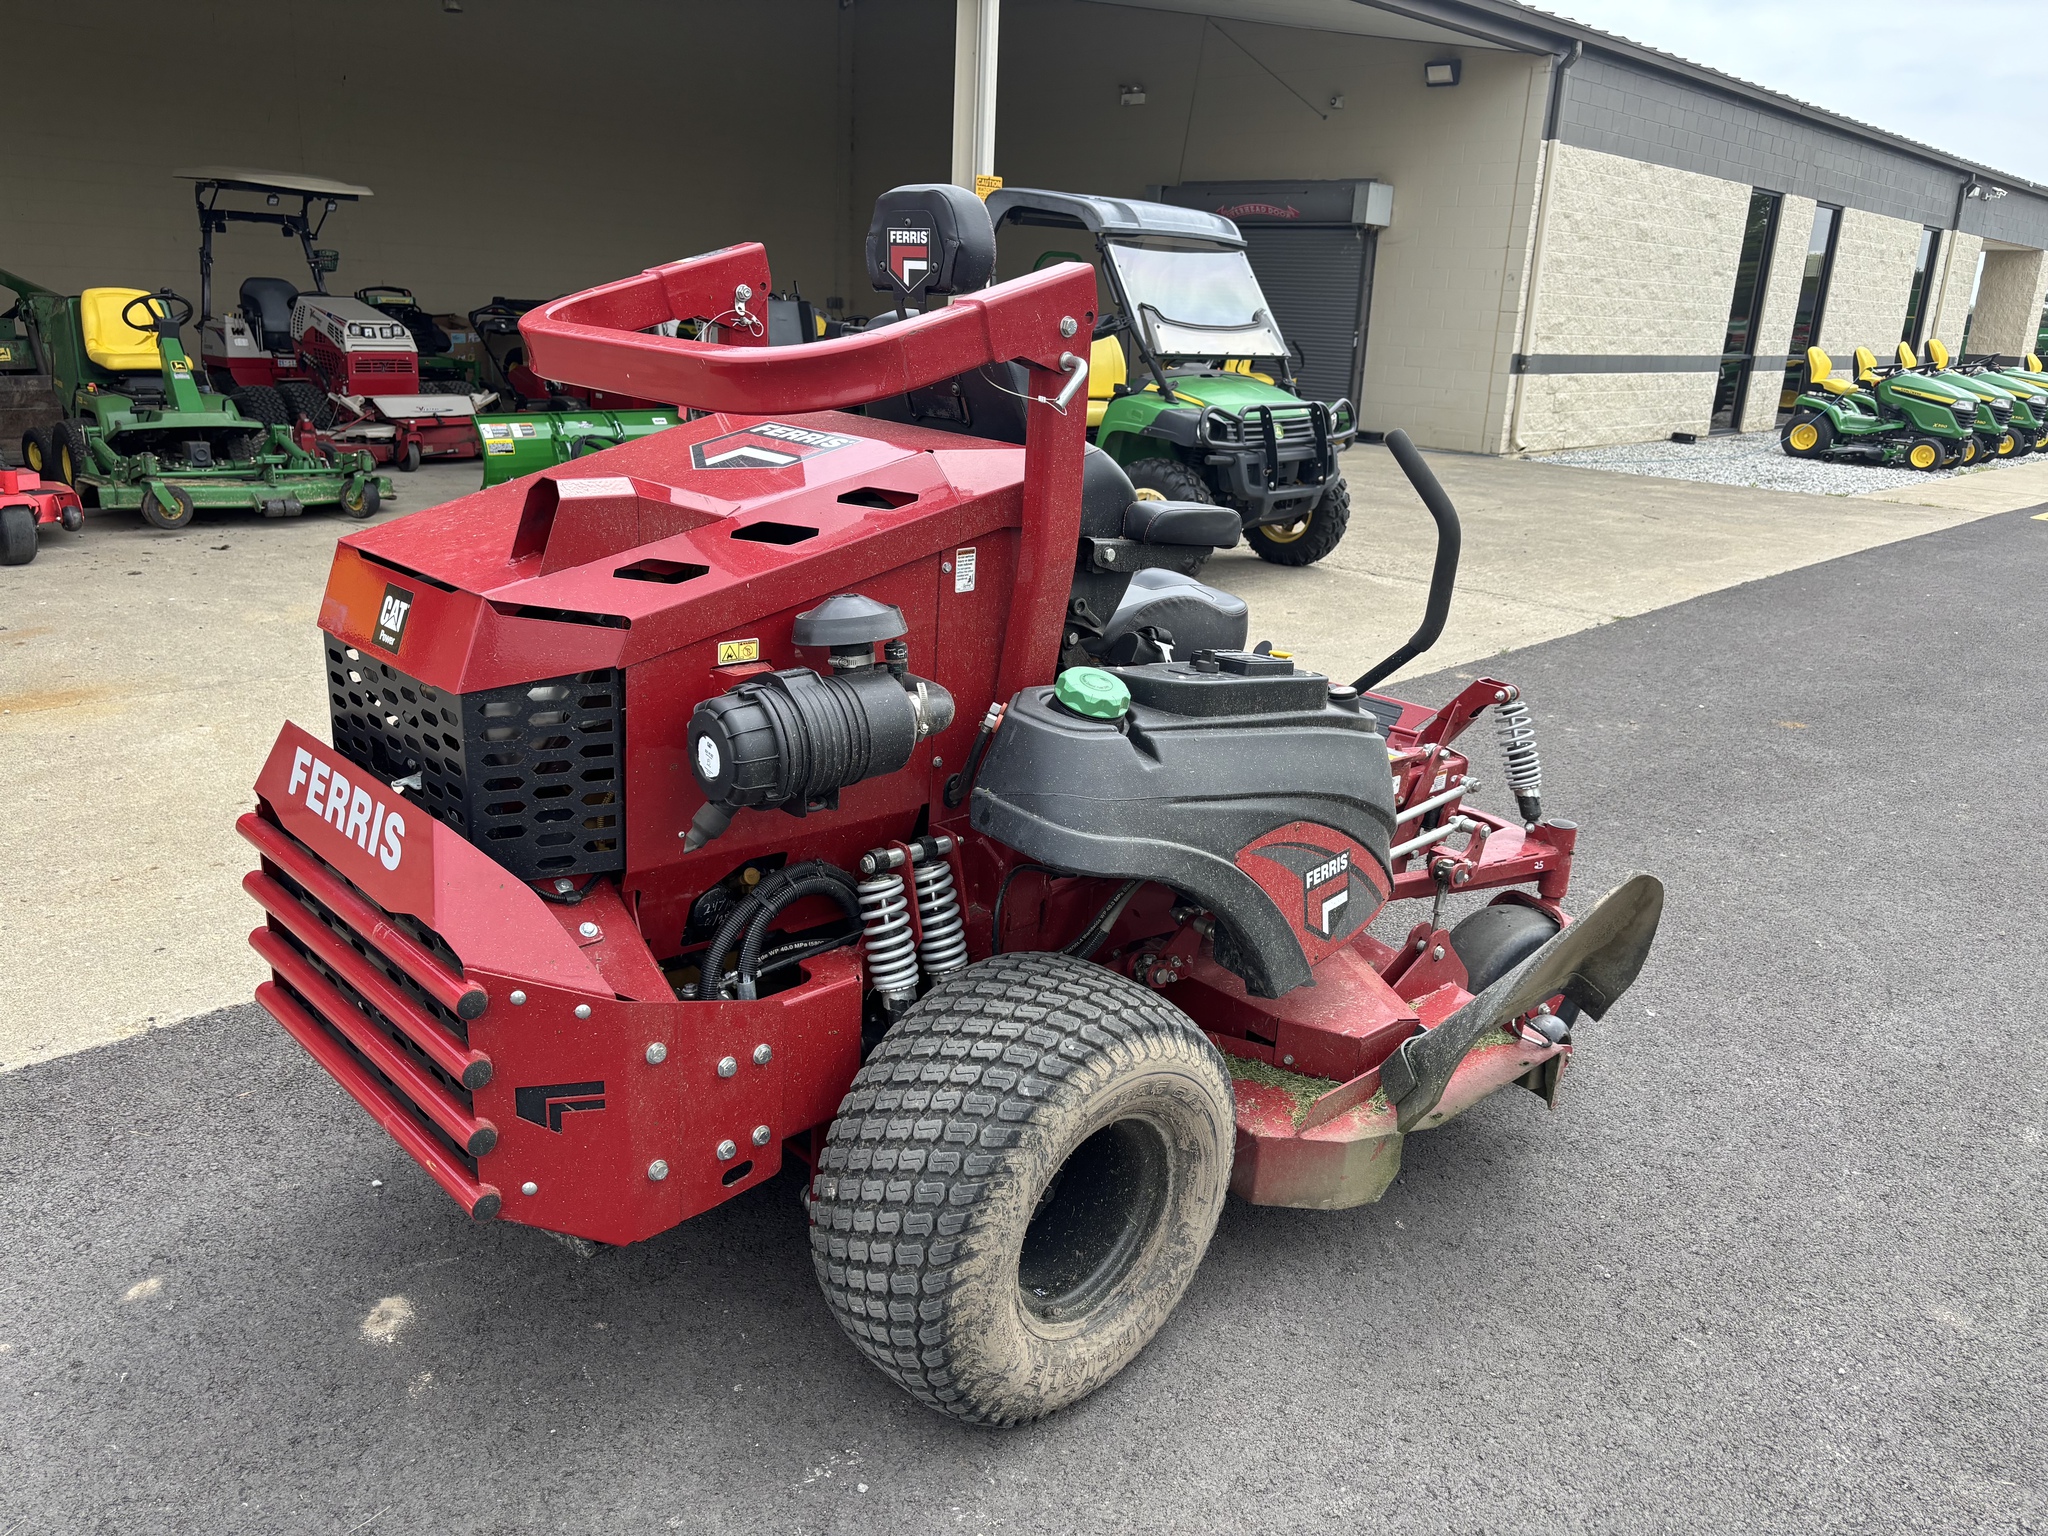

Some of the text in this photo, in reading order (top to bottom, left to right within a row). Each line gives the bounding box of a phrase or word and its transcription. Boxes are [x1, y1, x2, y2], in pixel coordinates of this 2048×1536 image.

[977, 178, 1002, 188] CAUTION
[890, 230, 928, 244] FERRIS
[750, 423, 846, 448] FERRIS
[380, 595, 409, 632] CAT
[379, 629, 396, 646] Power
[288, 745, 406, 871] FERRIS
[1306, 852, 1349, 889] FERRIS
[1534, 860, 1544, 869] 25
[769, 948, 779, 956] WP
